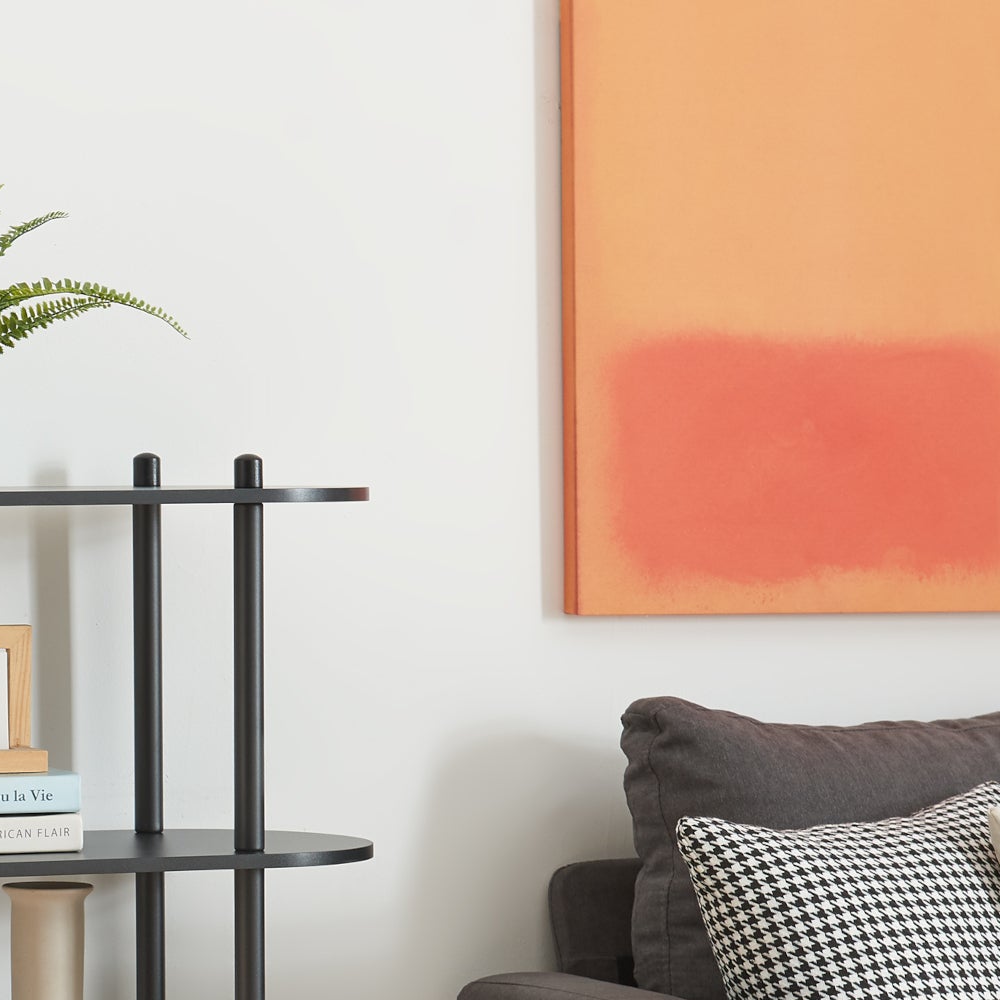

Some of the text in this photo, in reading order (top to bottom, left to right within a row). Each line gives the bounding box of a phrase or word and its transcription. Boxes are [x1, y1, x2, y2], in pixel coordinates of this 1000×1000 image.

[14, 790, 26, 802] la
[30, 789, 53, 801] Vie
[37, 827, 70, 838] FLAIR
